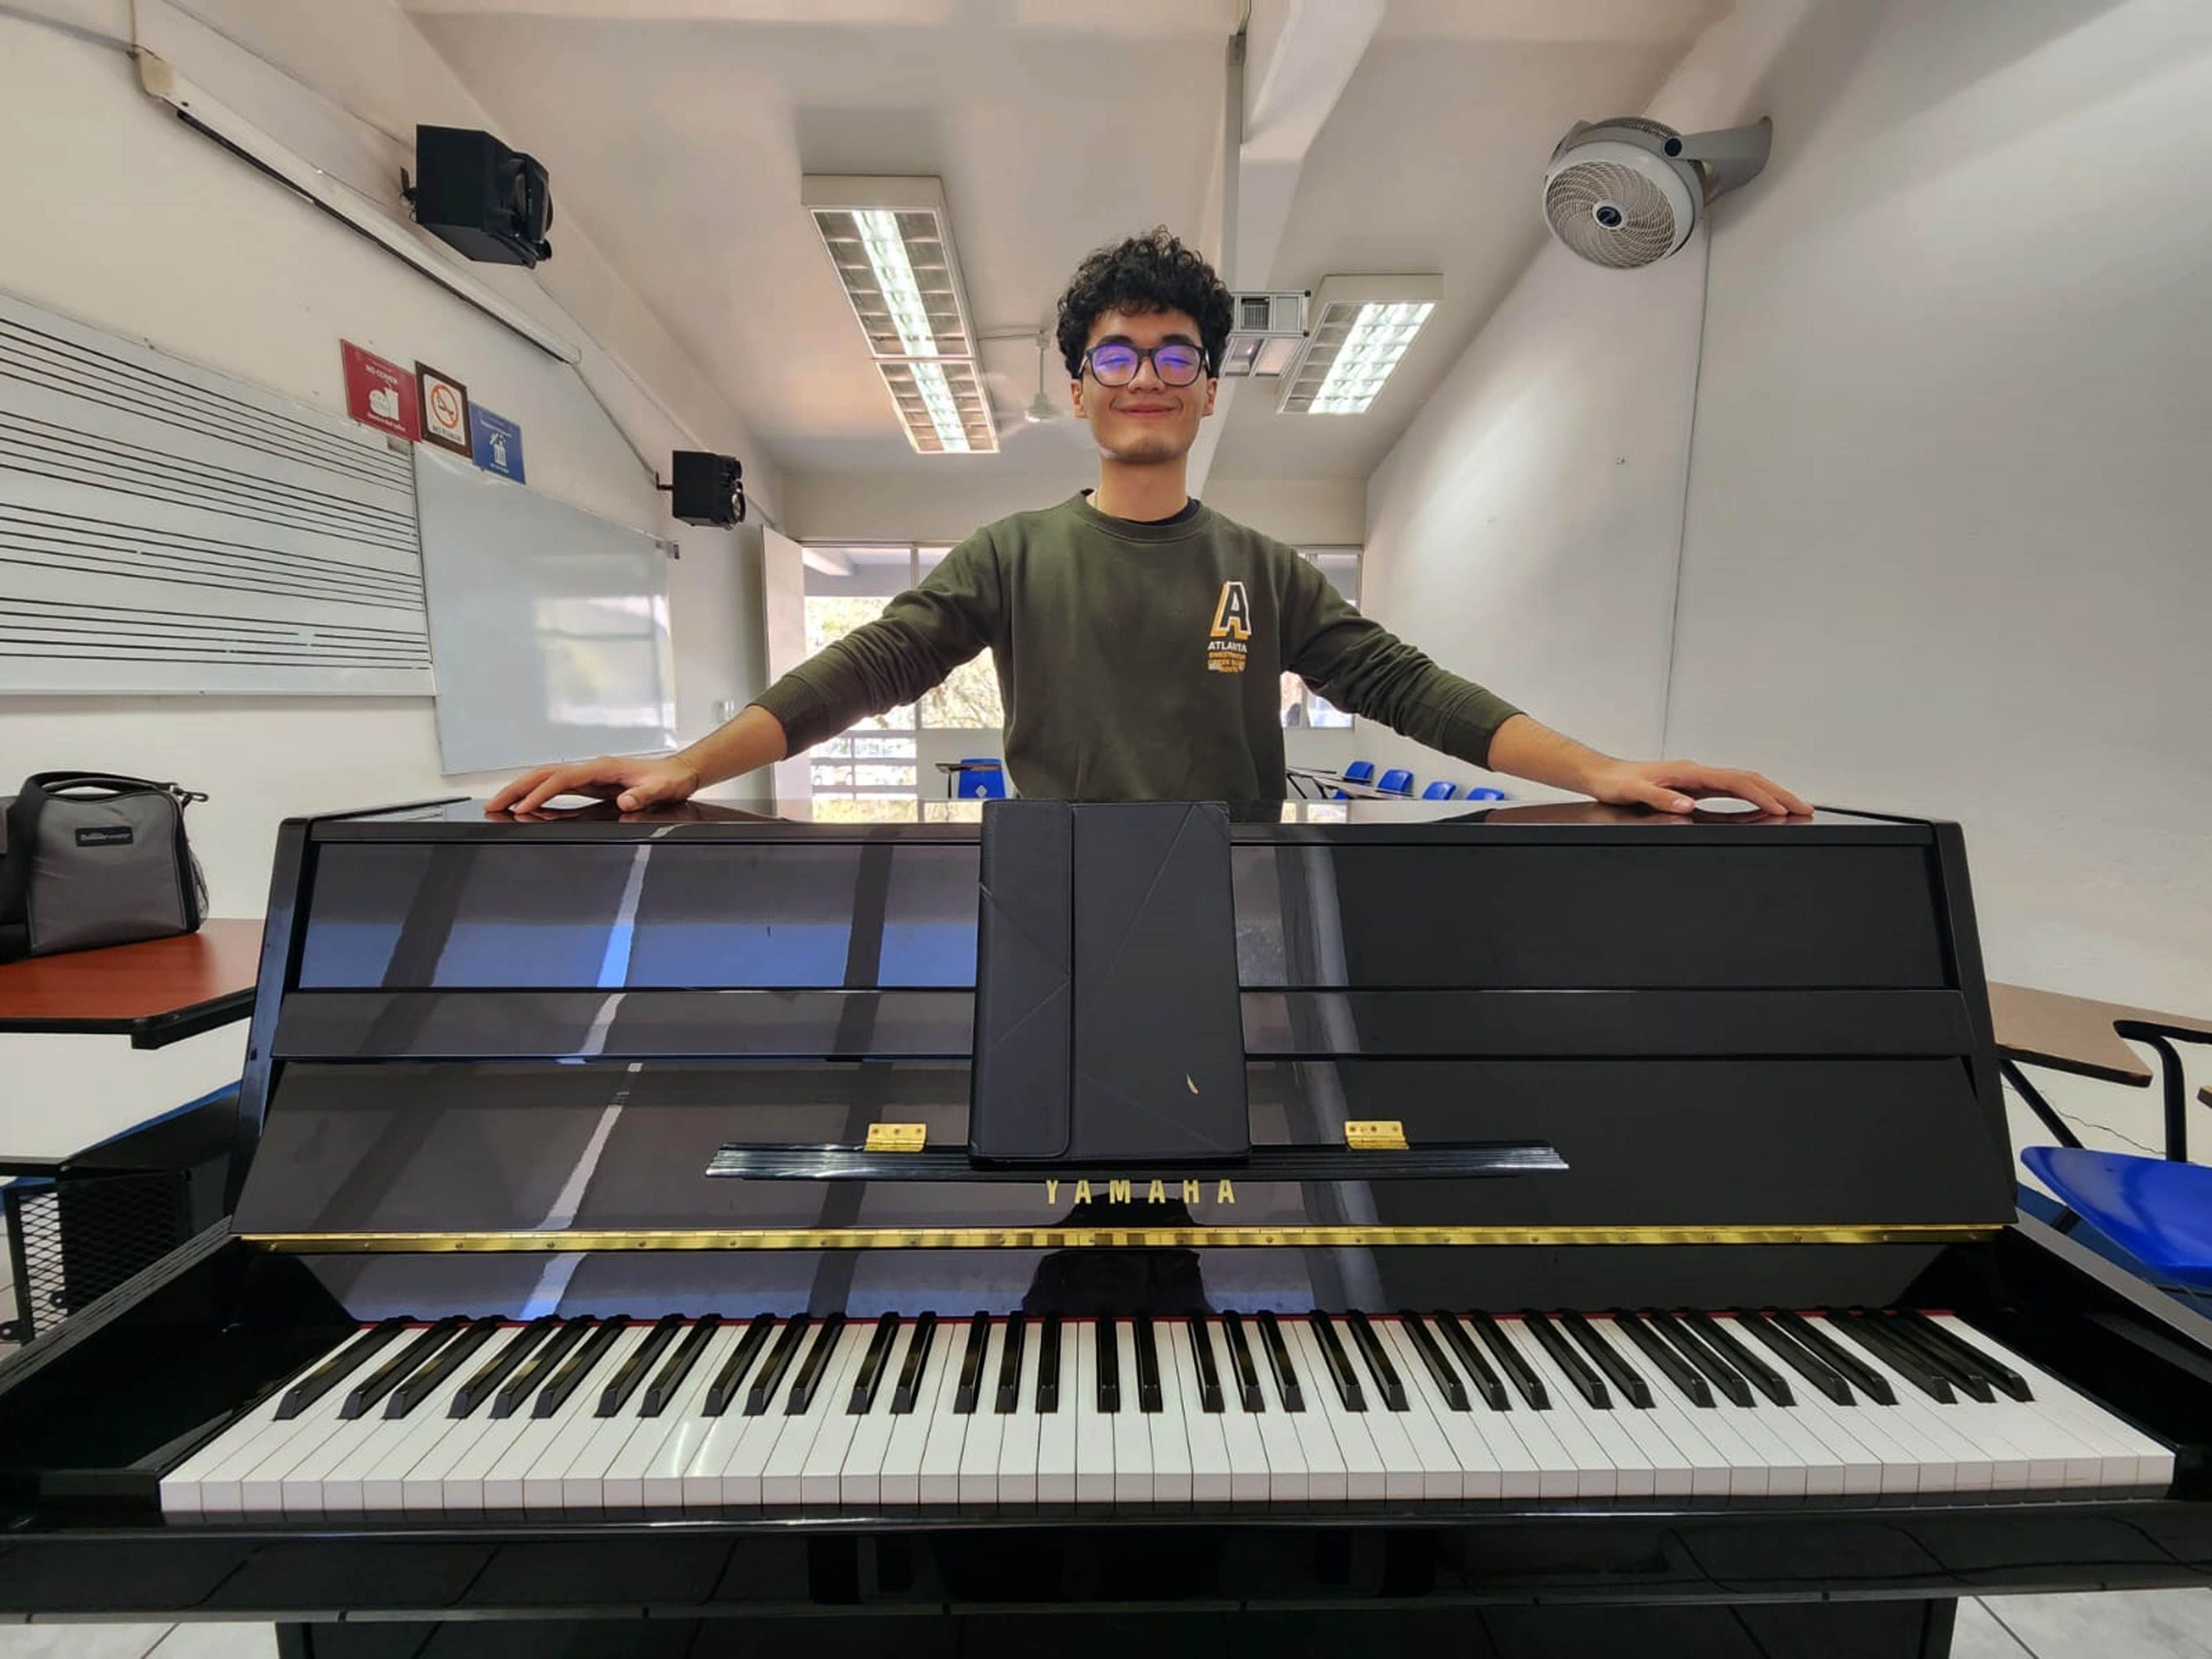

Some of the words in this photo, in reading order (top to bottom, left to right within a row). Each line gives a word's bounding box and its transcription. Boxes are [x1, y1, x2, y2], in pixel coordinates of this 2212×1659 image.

[365, 363, 376, 375] NO
[376, 369, 399, 384] COMER
[1210, 581, 1252, 639] A
[1208, 641, 1247, 652] ATLANTA
[1046, 1179, 1235, 1204] YAMAHA
